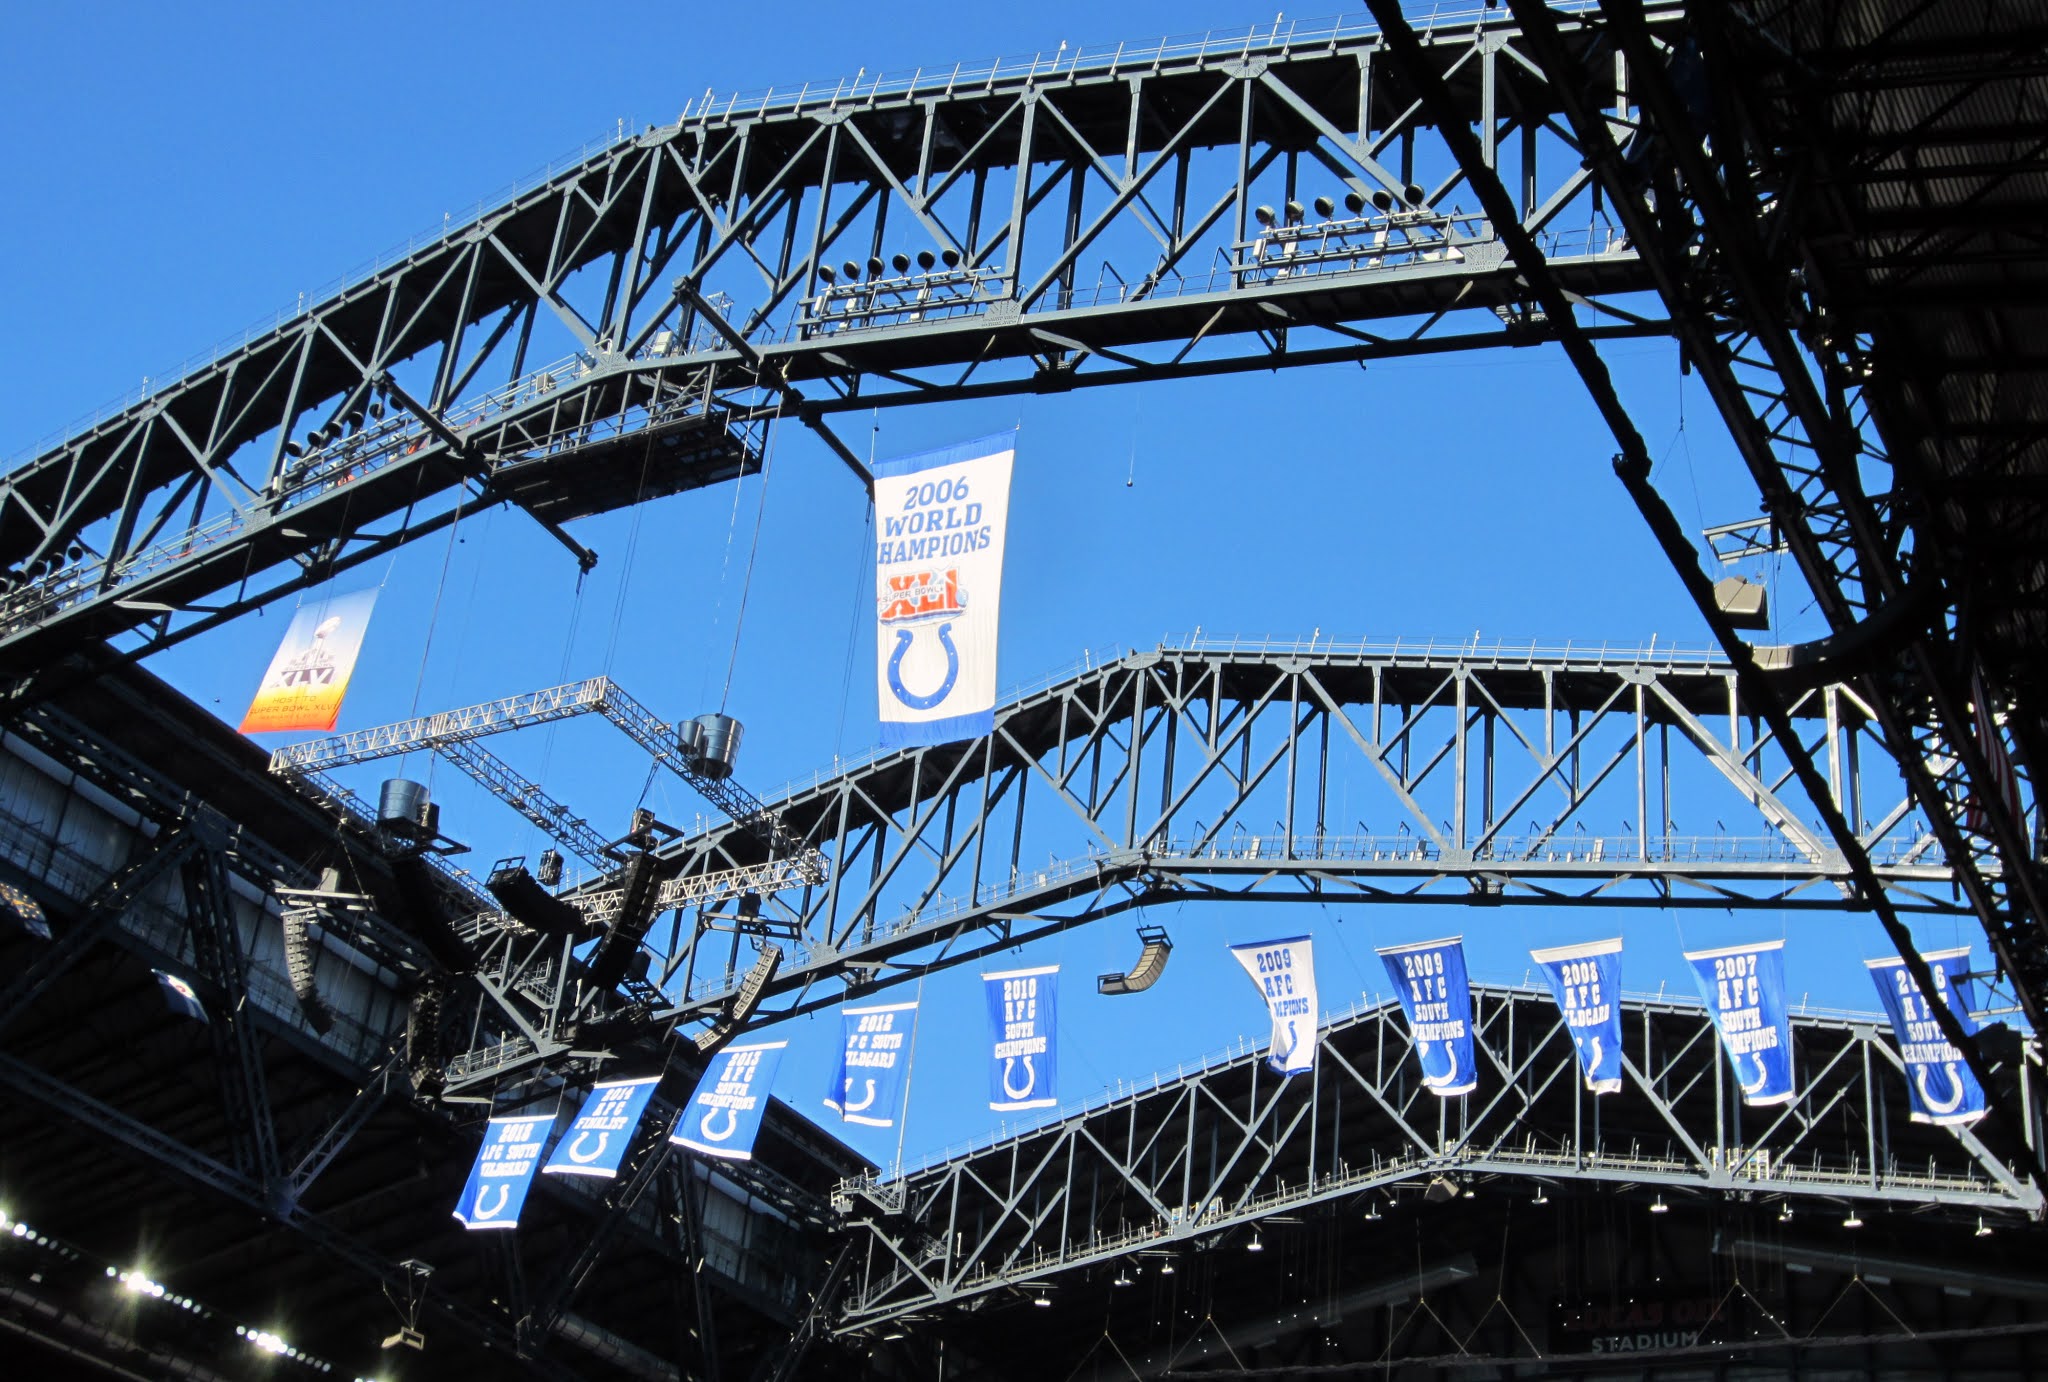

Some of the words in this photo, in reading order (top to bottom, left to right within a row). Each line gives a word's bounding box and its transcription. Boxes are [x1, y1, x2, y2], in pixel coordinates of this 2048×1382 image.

[903, 476, 969, 510] 2006
[885, 503, 982, 537] WORLD
[877, 525, 991, 565] HAMPIONS
[882, 590, 911, 603] SUPER
[914, 586, 940, 596] BOWL
[272, 696, 300, 704] HOST
[281, 705, 310, 713] BOWL
[1257, 948, 1292, 973] 2009
[1404, 952, 1444, 979] 2009
[1715, 954, 1757, 980] 2007
[1562, 961, 1599, 987] 2008
[1003, 978, 1037, 1001] 2010
[1263, 974, 1293, 998] AFC
[1410, 976, 1447, 1002] AFC
[1565, 984, 1600, 1009] AFC
[1718, 976, 1759, 1010] AFC
[1005, 999, 1036, 1022] AFC
[1415, 1002, 1449, 1022] SOUTH
[1720, 1006, 1762, 1033] SOUTH
[858, 1013, 894, 1032] 2012
[1005, 1021, 1034, 1040] SOUTH
[1907, 1020, 1946, 1042] SOUT
[871, 1033, 903, 1049] SOUTH
[994, 1037, 1047, 1059] CHAMPIONS
[727, 1050, 762, 1067] 2013
[1902, 1042, 1964, 1063] CHAMPION
[720, 1066, 755, 1083] AFC
[601, 1086, 636, 1101] 2014
[715, 1081, 750, 1097] SOUTH
[591, 1101, 627, 1117] AFC
[697, 1092, 757, 1110] CHAMPIONS
[574, 1116, 629, 1130] FINALIST
[505, 1142, 541, 1160] SOUTH
[1591, 1330, 1698, 1353] STADIUM
